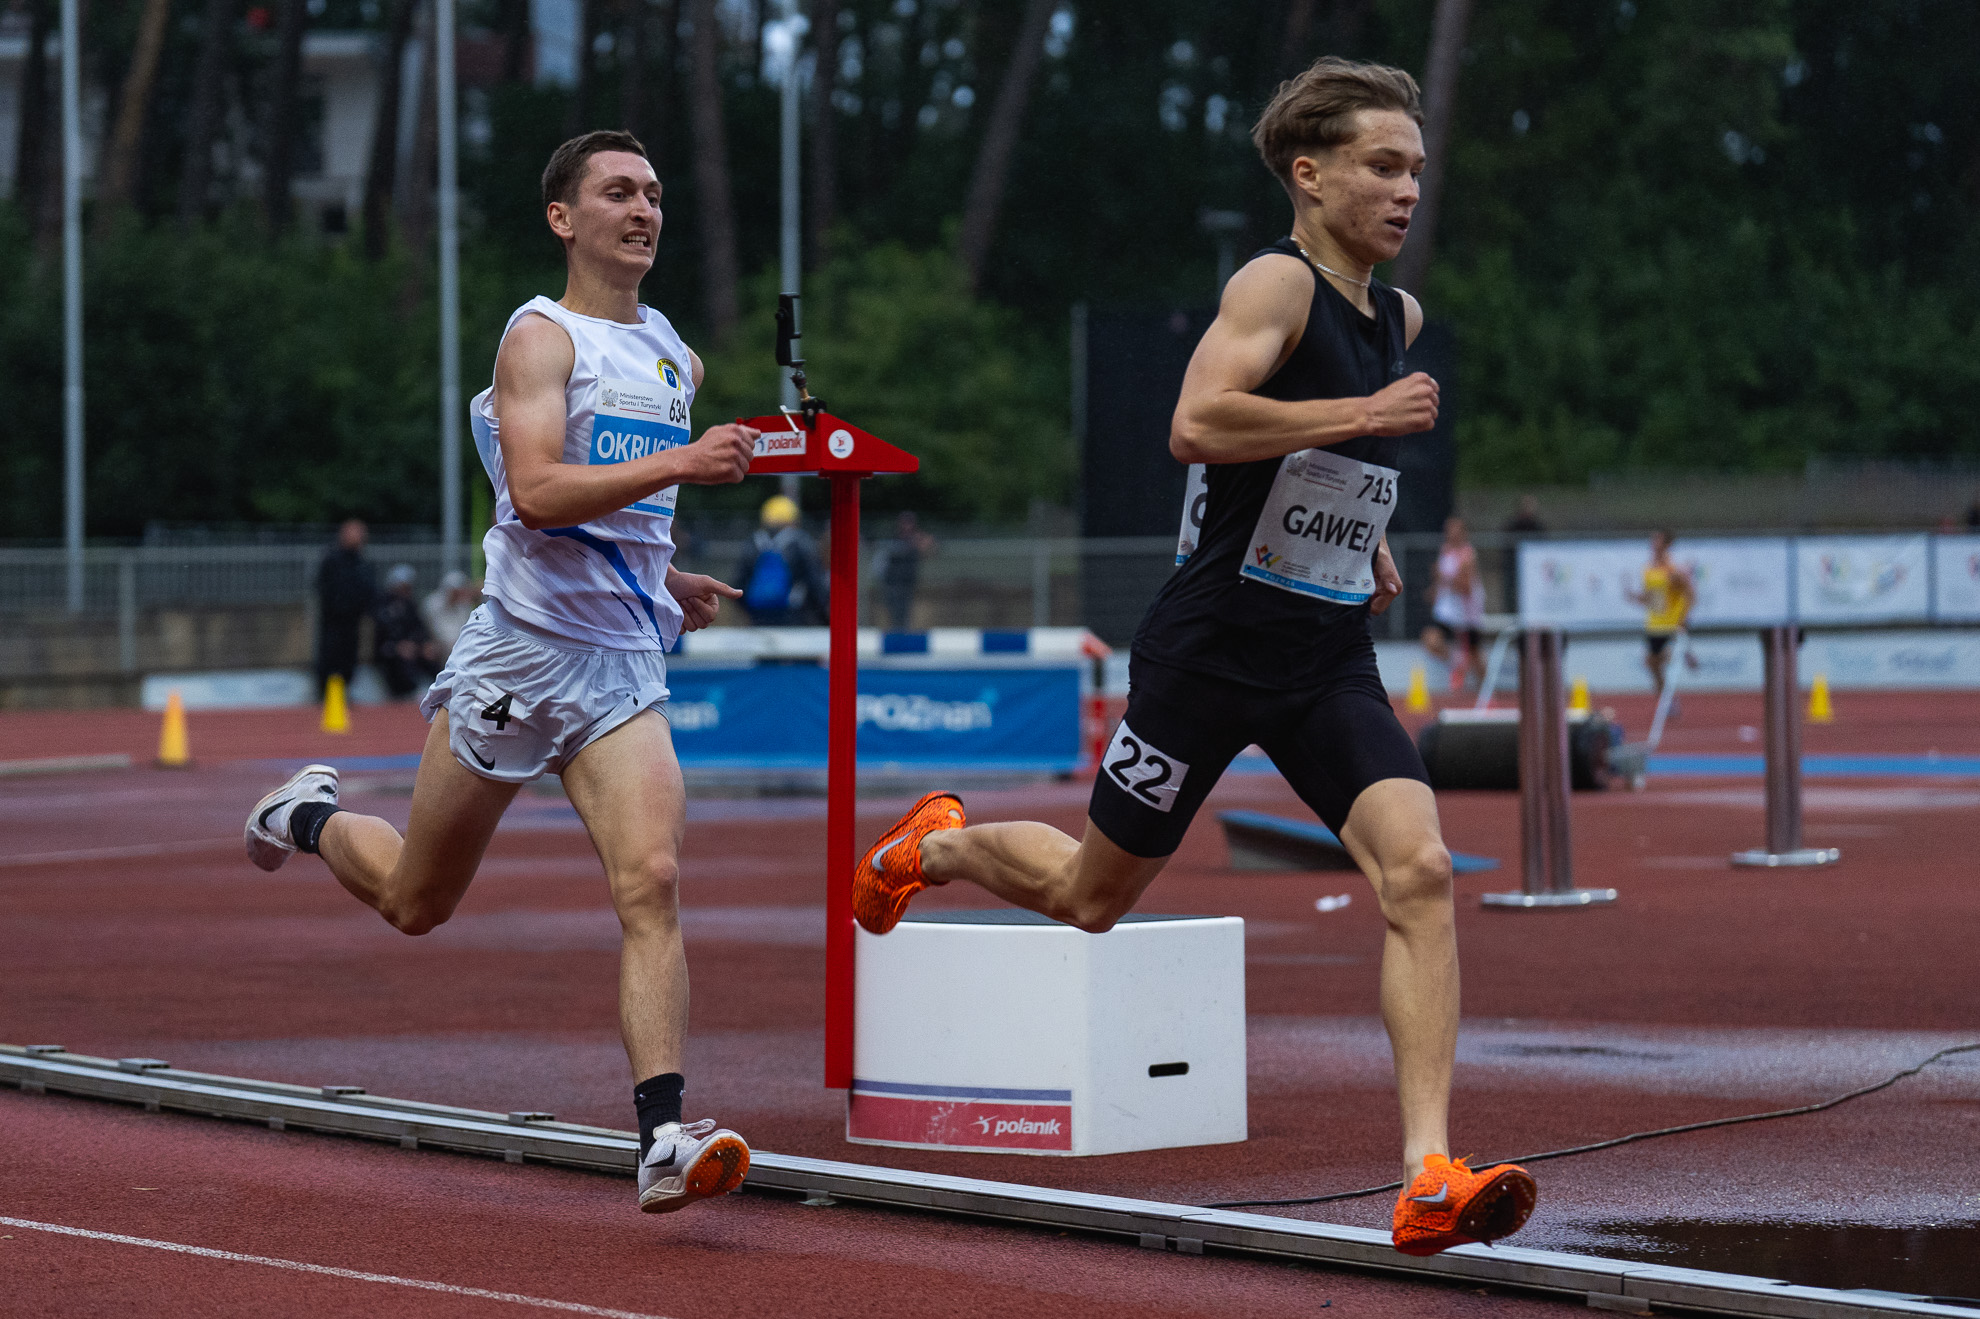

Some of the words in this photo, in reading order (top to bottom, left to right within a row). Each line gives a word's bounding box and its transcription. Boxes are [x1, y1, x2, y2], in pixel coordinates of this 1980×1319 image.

[619, 392, 653, 402] Ministerstwo
[619, 399, 636, 407] Sportu
[640, 402, 662, 410] Turystyki
[669, 398, 687, 425] 634
[767, 435, 803, 453] polanik
[1357, 473, 1392, 505] 715
[480, 694, 513, 731] 4
[1109, 736, 1172, 805] 22
[994, 1117, 1061, 1136] polanik
